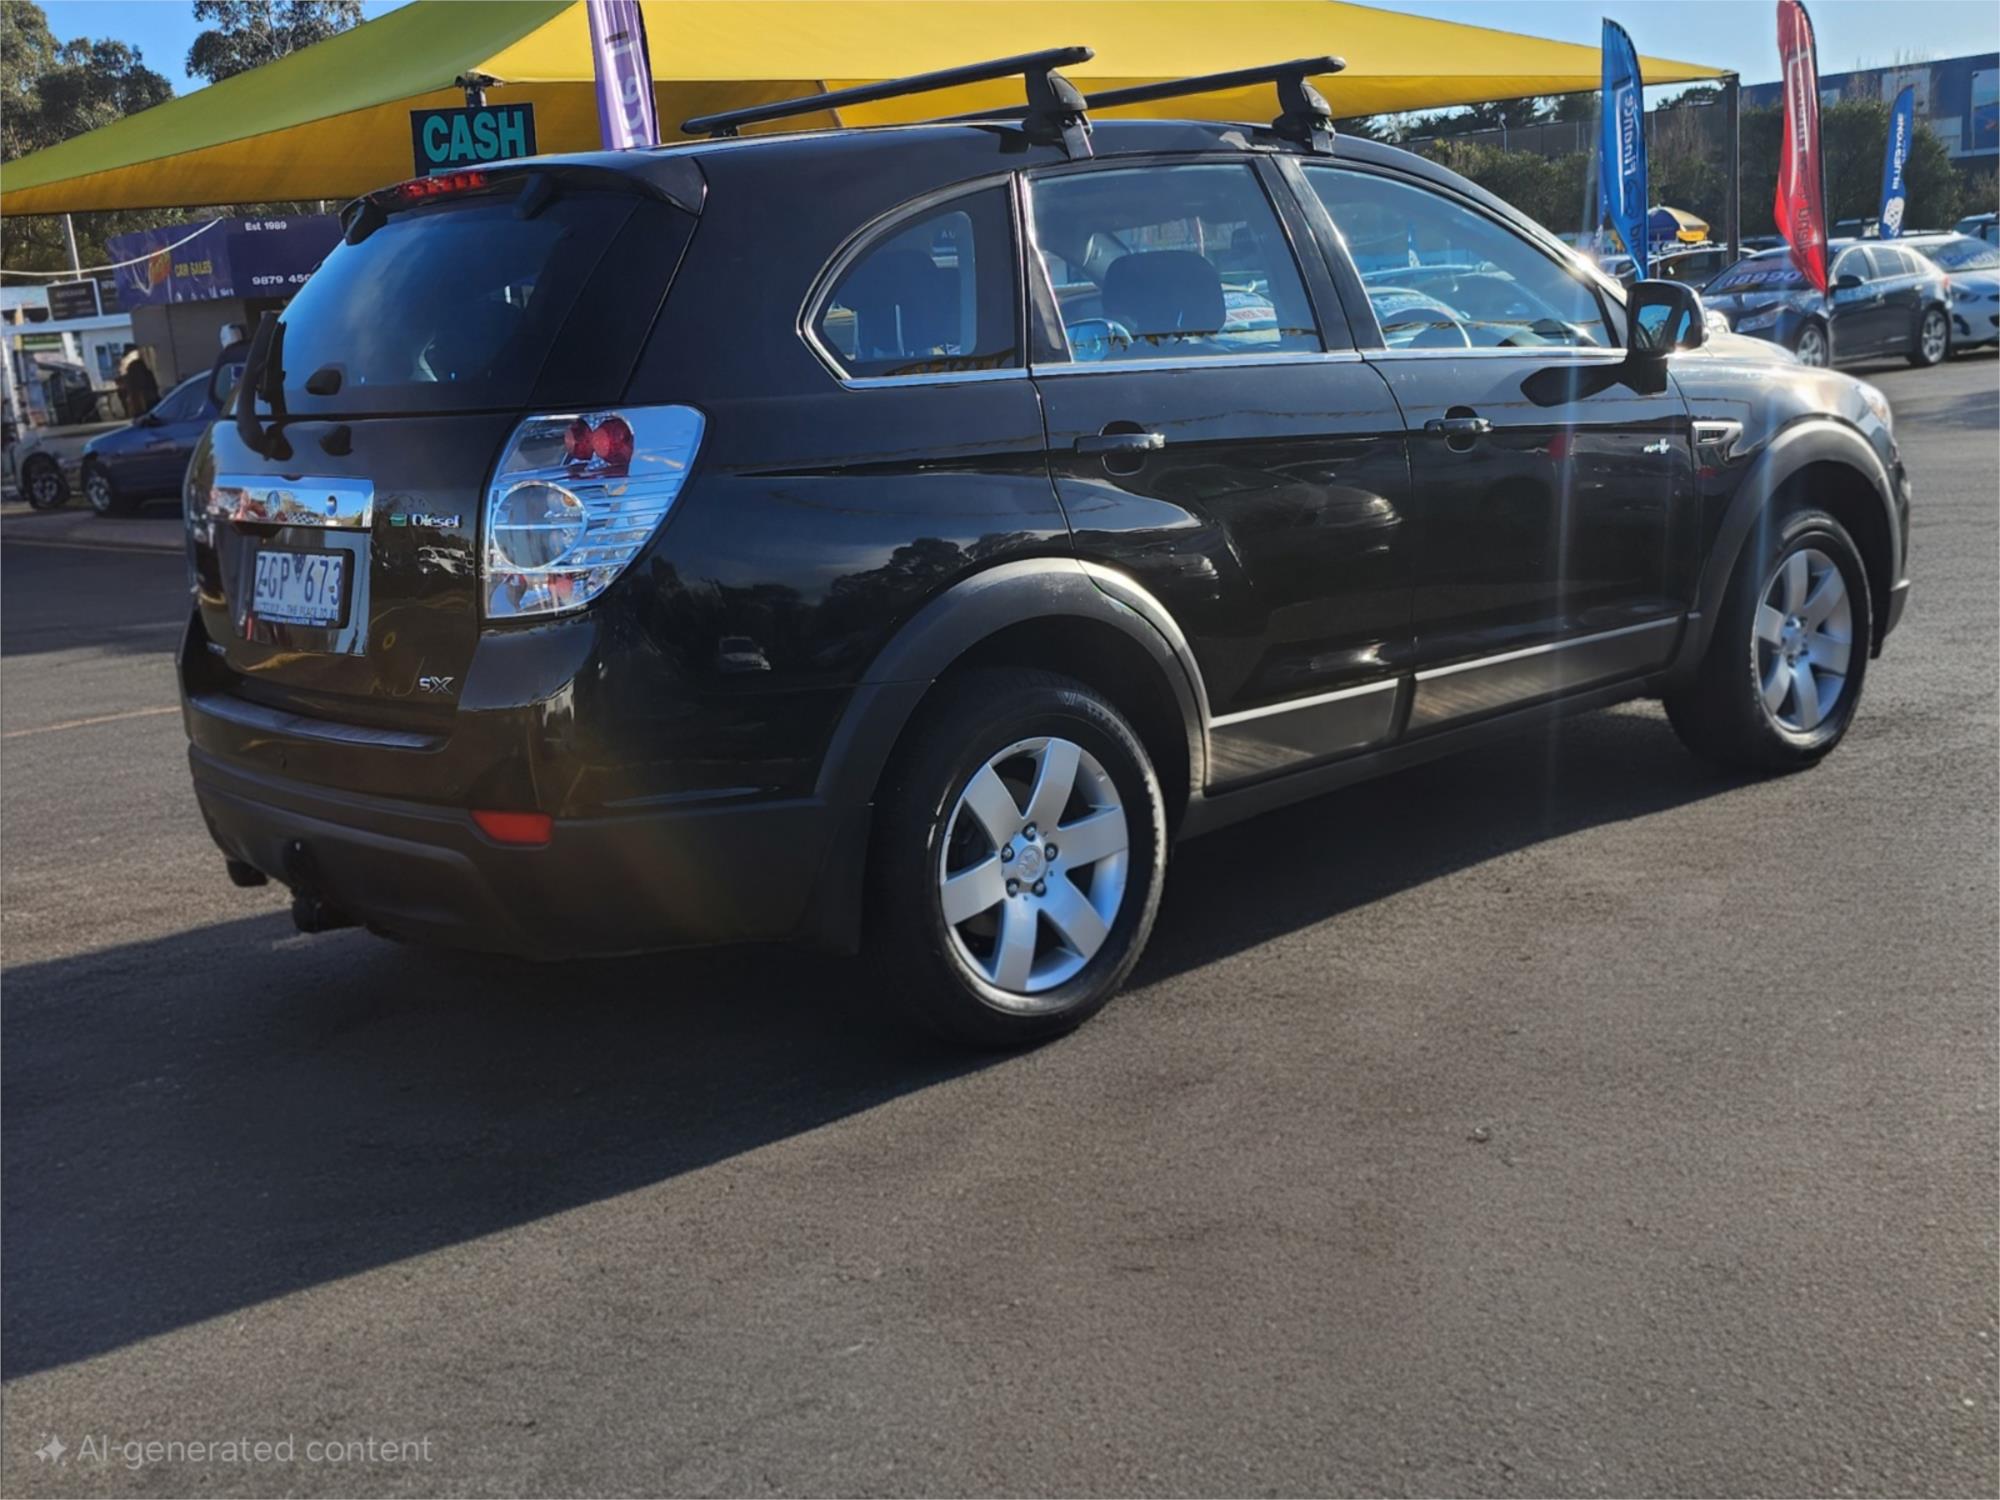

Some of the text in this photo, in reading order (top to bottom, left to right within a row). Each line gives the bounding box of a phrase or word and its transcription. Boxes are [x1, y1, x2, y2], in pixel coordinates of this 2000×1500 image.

[423, 110, 526, 162] CASH
[1891, 113, 1905, 190] BLUESTONE
[245, 221, 287, 231] Est 1989
[252, 276, 284, 285] 9879
[412, 513, 460, 528] Diesel
[304, 560, 341, 605] 673
[419, 676, 454, 695] SX
